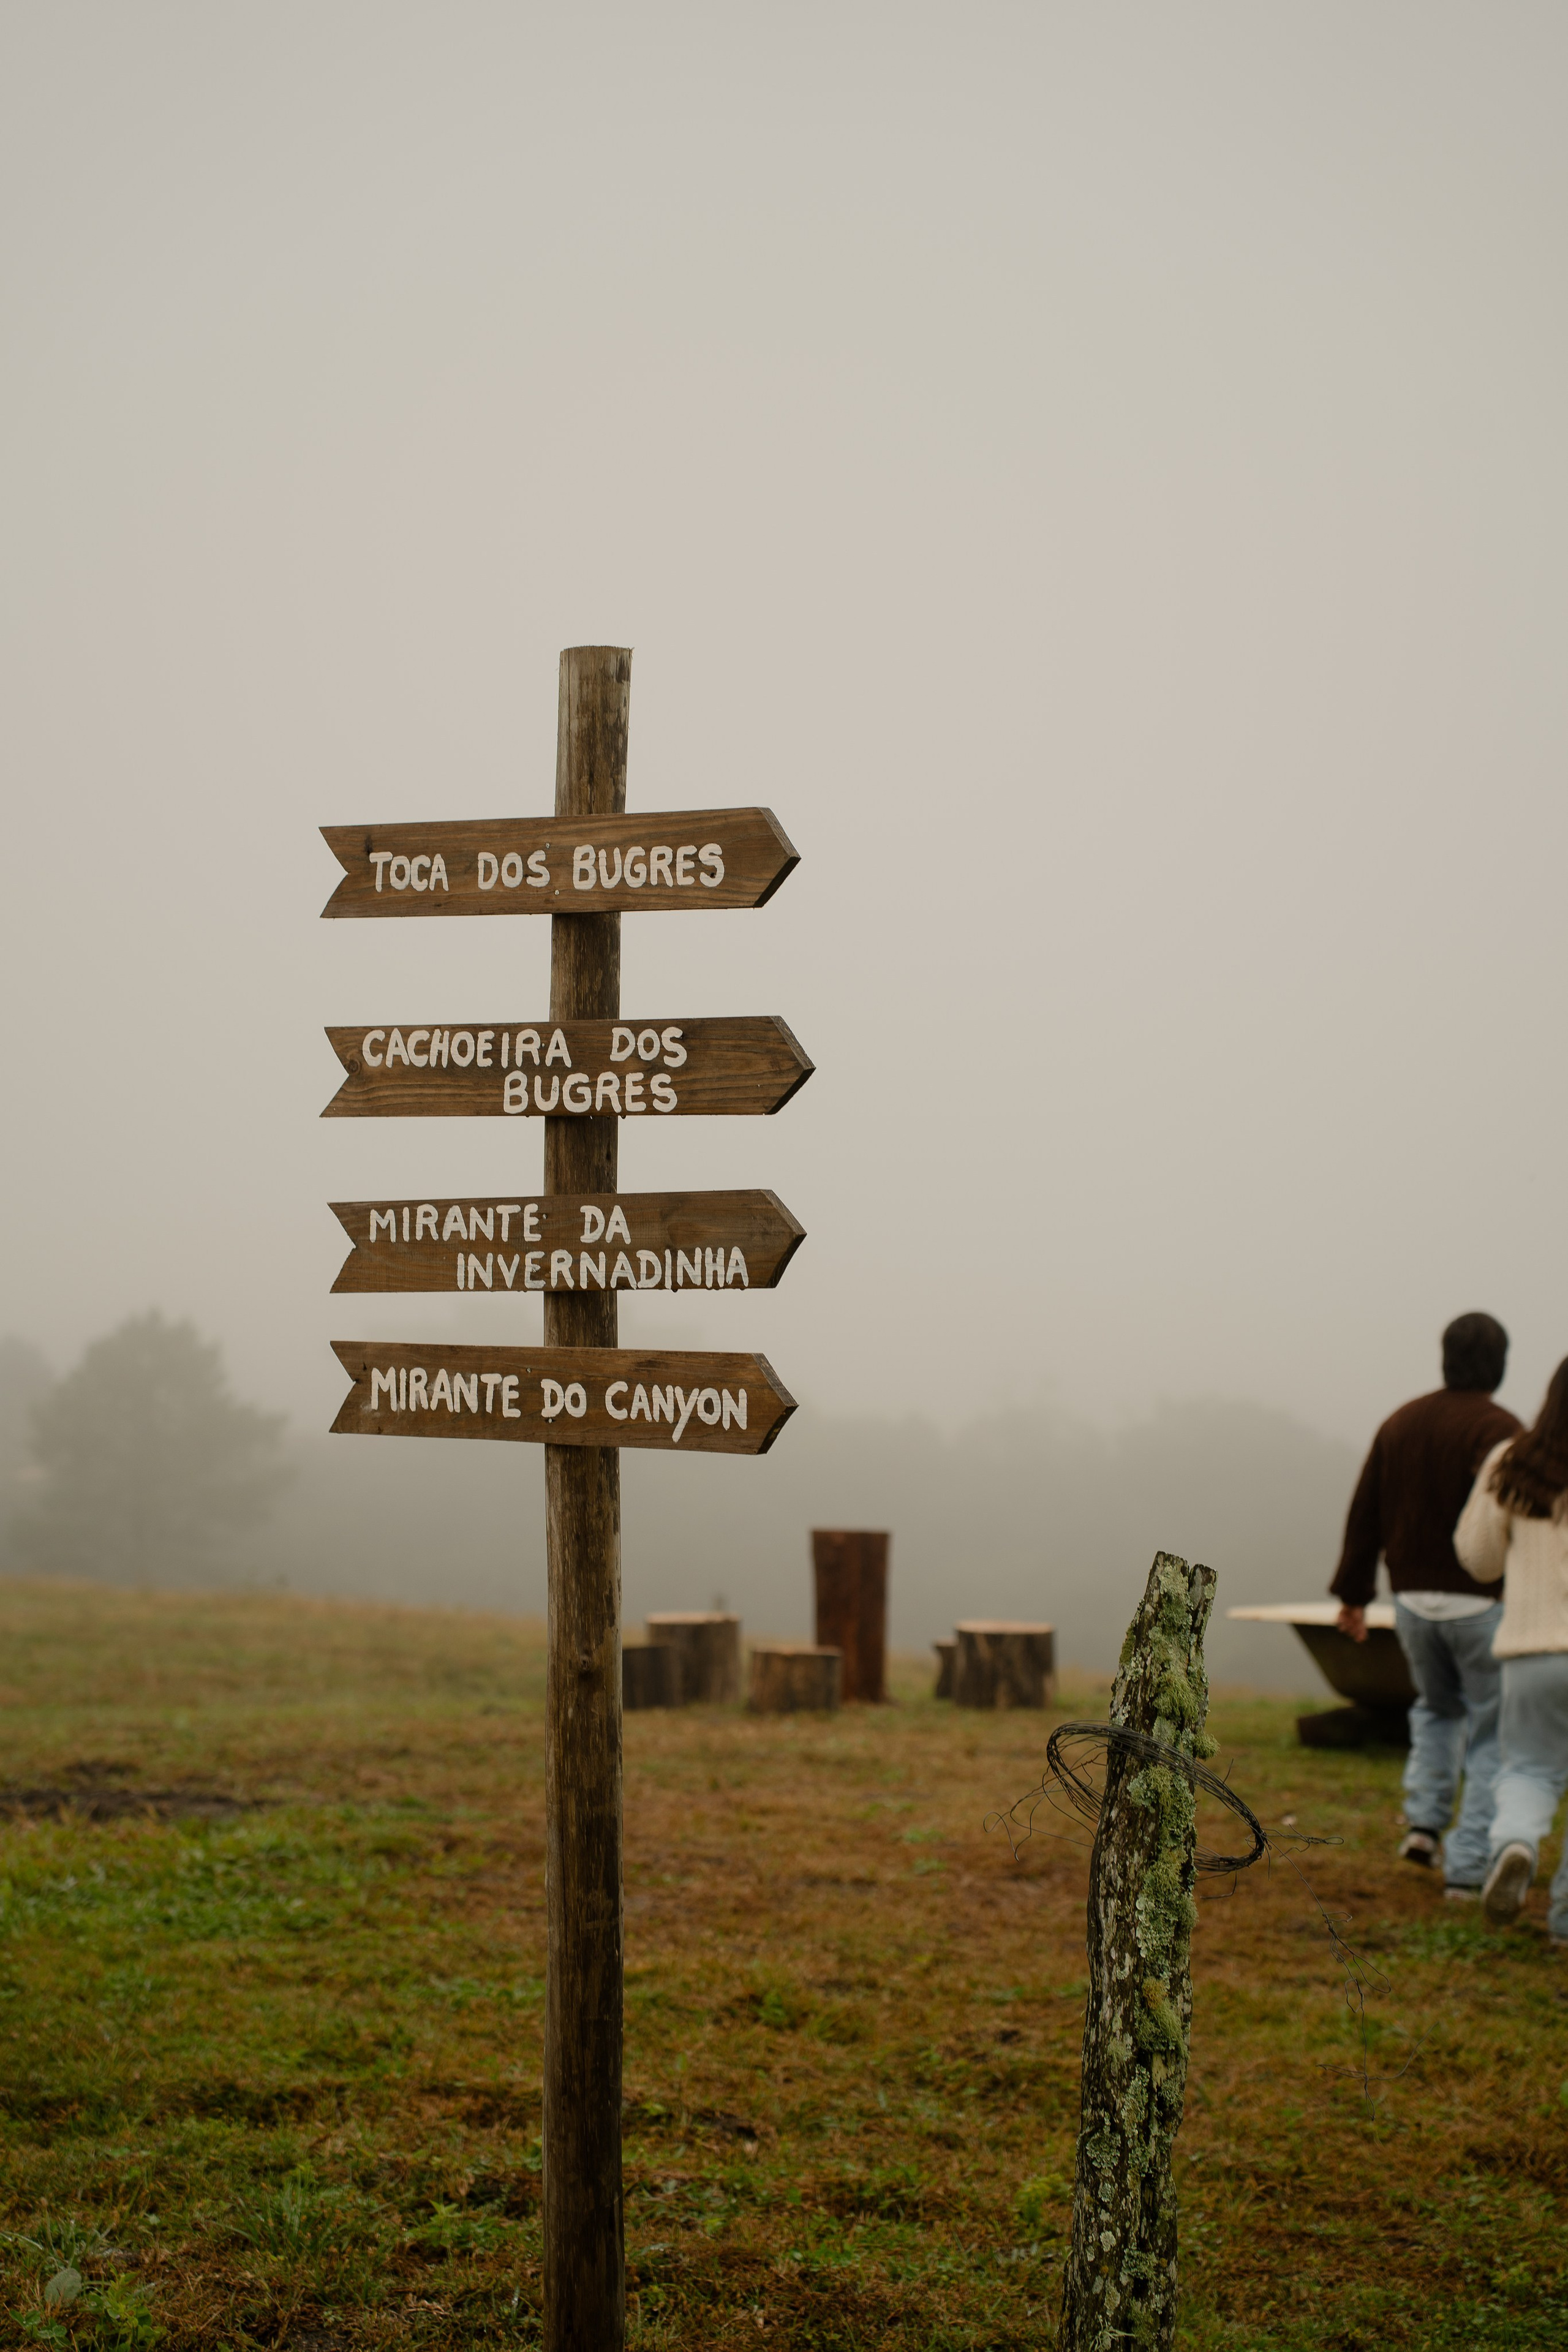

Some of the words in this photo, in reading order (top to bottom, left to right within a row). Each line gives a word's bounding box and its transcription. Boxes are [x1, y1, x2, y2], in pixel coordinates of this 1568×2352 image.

[369, 852, 448, 892] TOCA
[478, 850, 550, 889] DOS
[573, 843, 725, 889] BUGRES
[363, 1028, 571, 1068] CACHOEIRA
[610, 1027, 687, 1067] DOS
[503, 1071, 677, 1114] BUGRES
[370, 1204, 541, 1243] MIRANTE
[581, 1205, 631, 1244] DA
[457, 1246, 748, 1289] INVERNADINHA
[371, 1366, 521, 1417] MIRANTE
[541, 1379, 586, 1417] DO
[605, 1381, 747, 1442] CANYON
